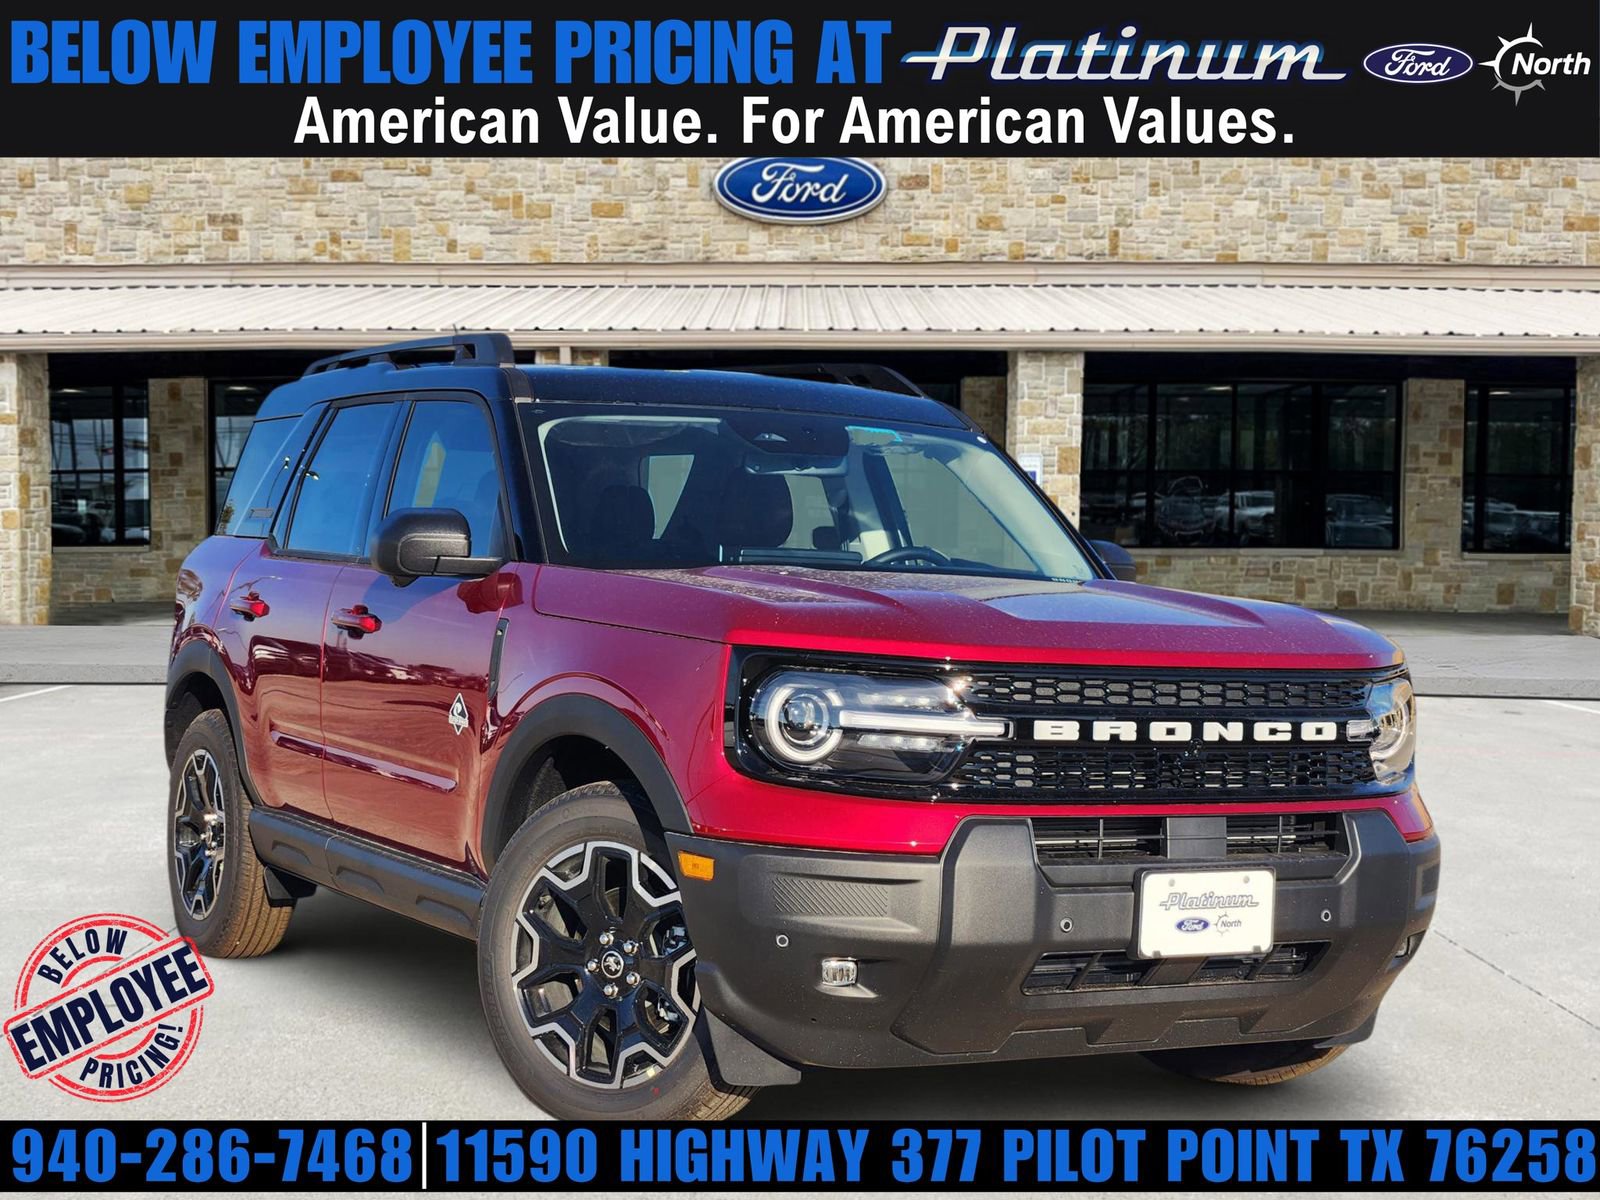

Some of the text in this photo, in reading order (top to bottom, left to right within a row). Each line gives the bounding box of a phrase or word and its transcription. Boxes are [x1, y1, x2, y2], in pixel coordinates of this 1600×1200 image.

[752, 162, 849, 203] Ford
[1033, 719, 1337, 742] BRONCO
[1159, 891, 1260, 911] Platinum
[1181, 919, 1205, 931] Ford
[1221, 919, 1242, 928] North
